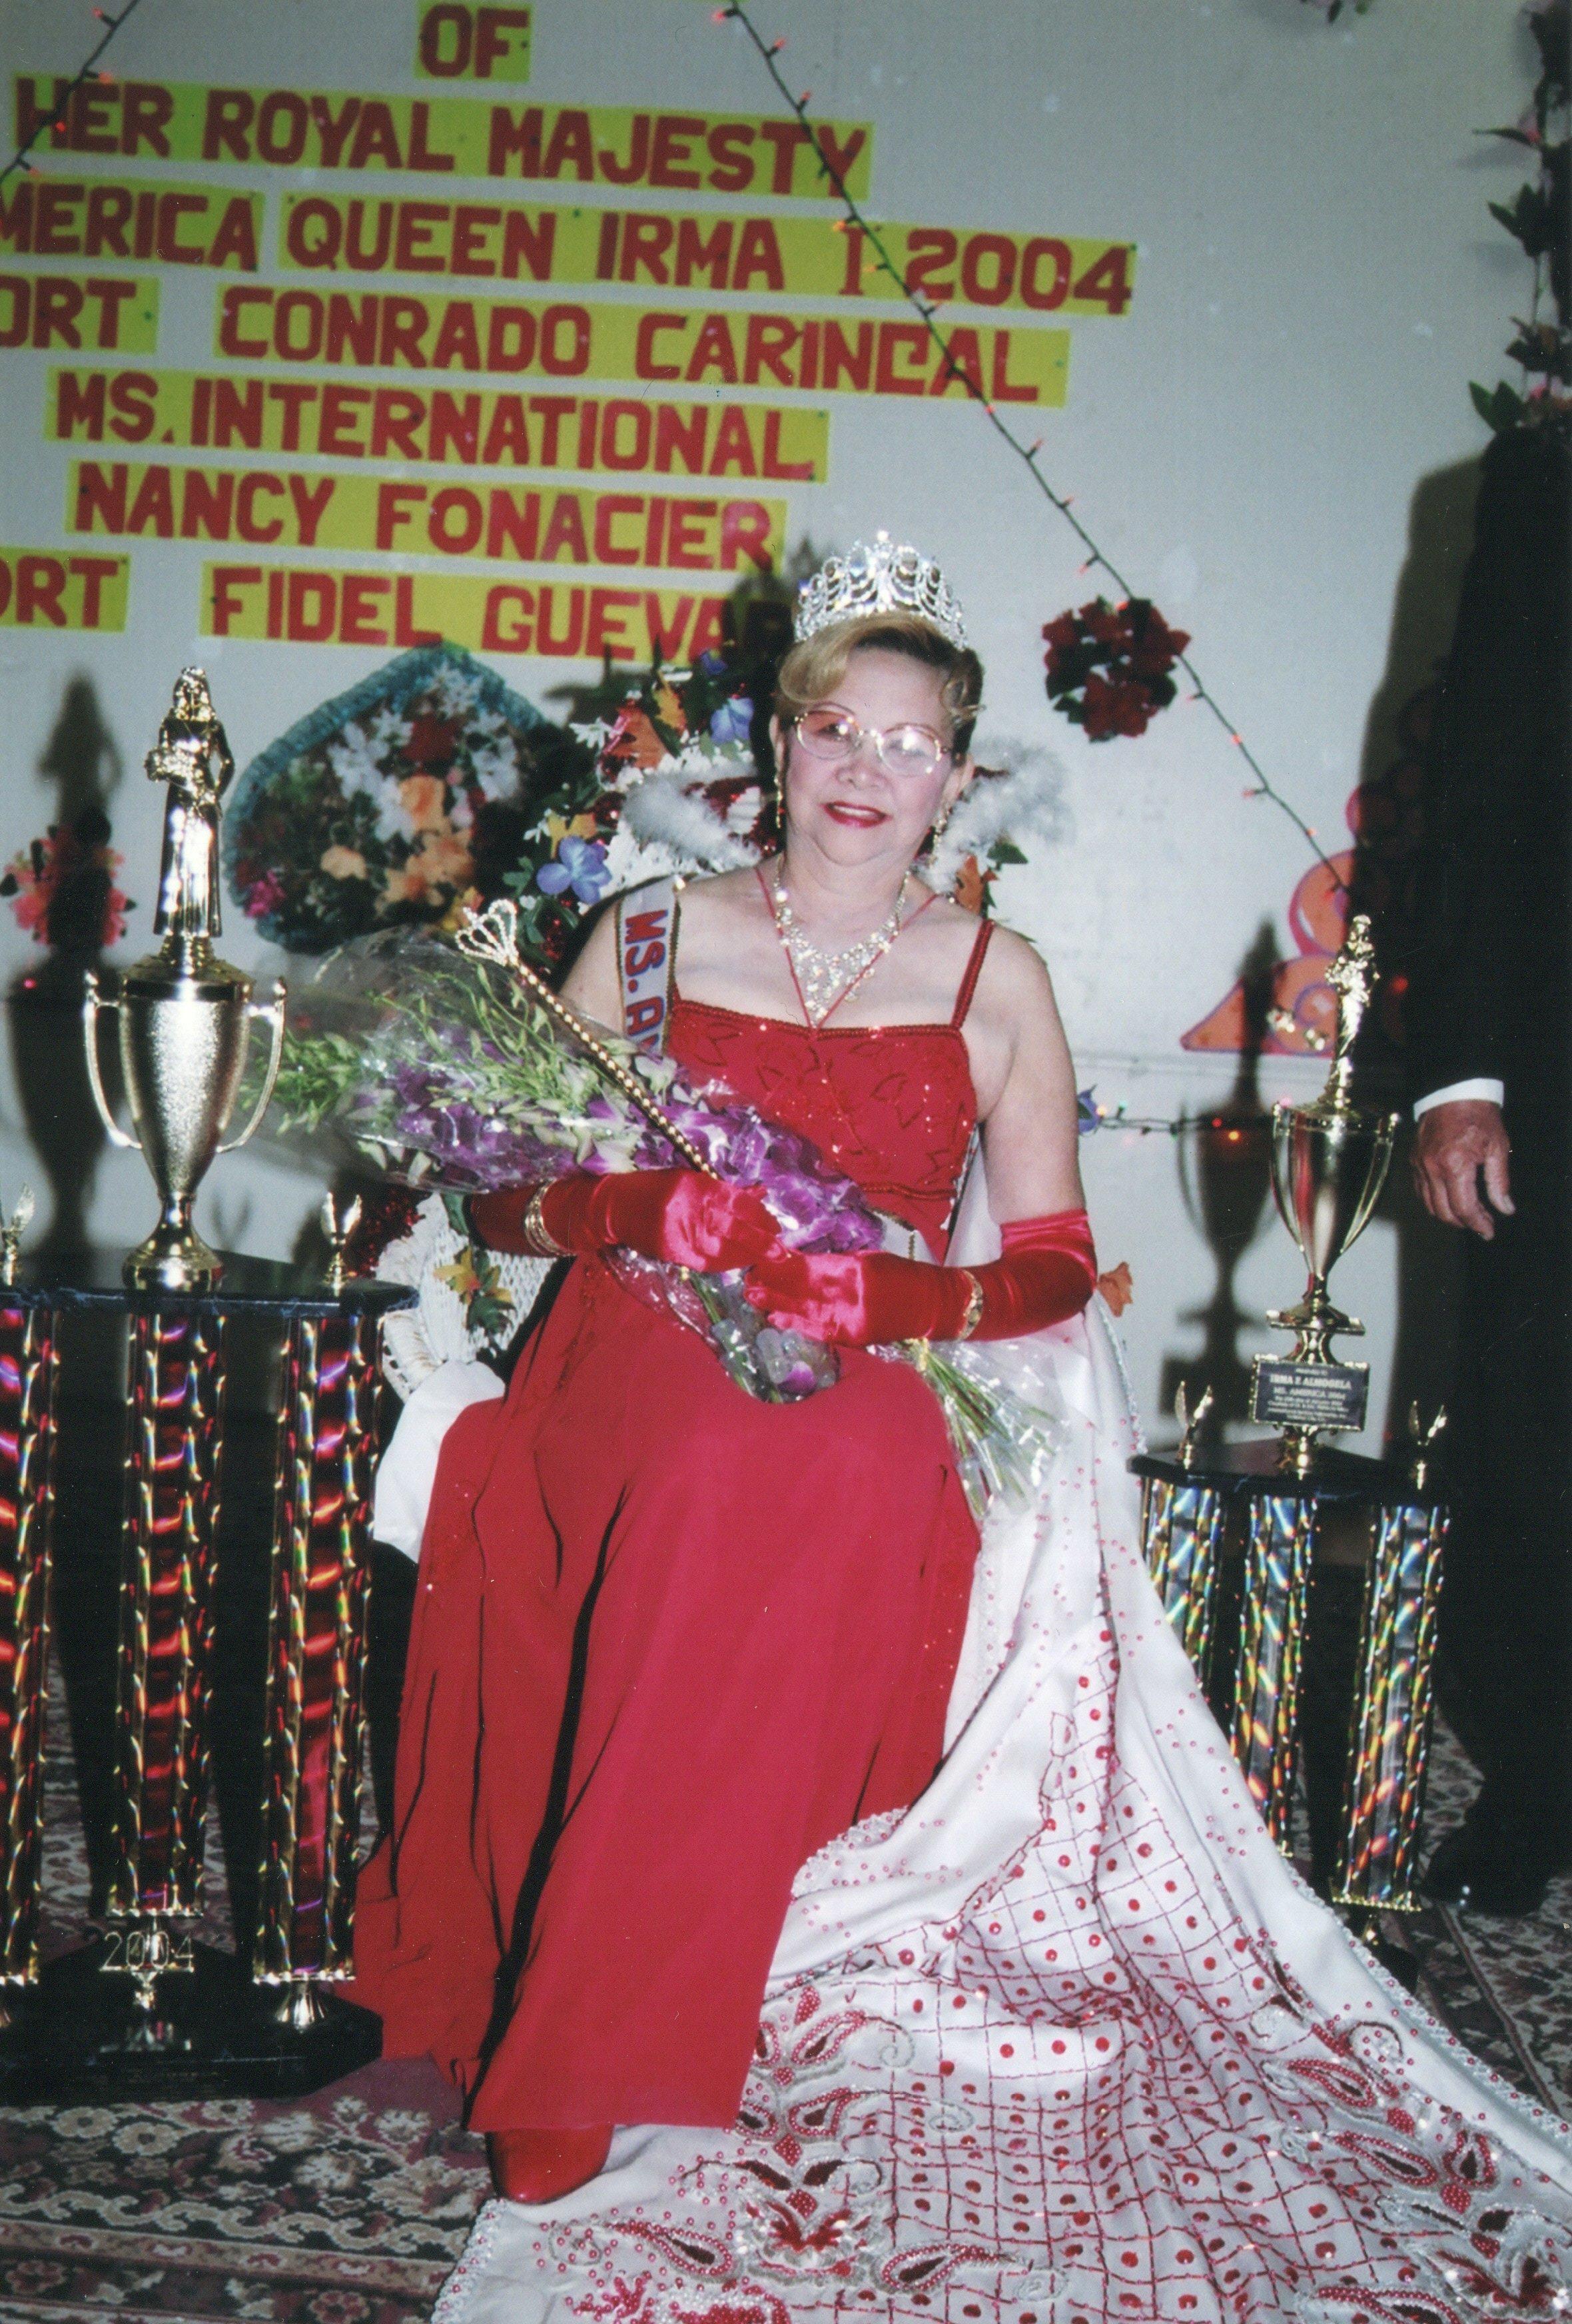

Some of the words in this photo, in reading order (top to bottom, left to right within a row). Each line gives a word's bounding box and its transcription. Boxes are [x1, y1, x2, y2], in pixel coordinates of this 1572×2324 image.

[420, 3, 529, 79] OF
[15, 77, 175, 158] HER
[202, 89, 455, 171] ROYAL
[488, 106, 867, 199] MAJESTY
[286, 198, 557, 282] QUEEN
[596, 212, 785, 291] IRMA
[838, 227, 866, 296] I
[906, 229, 1132, 315] 2004
[218, 285, 591, 376] CONRADO
[75, 461, 336, 548] NANCY
[375, 482, 773, 572] FONACIER
[0, 554, 119, 630] RT
[212, 566, 444, 648] FIDEL
[625, 909, 668, 993] MS.
[99, 1931, 194, 1973] 2004
